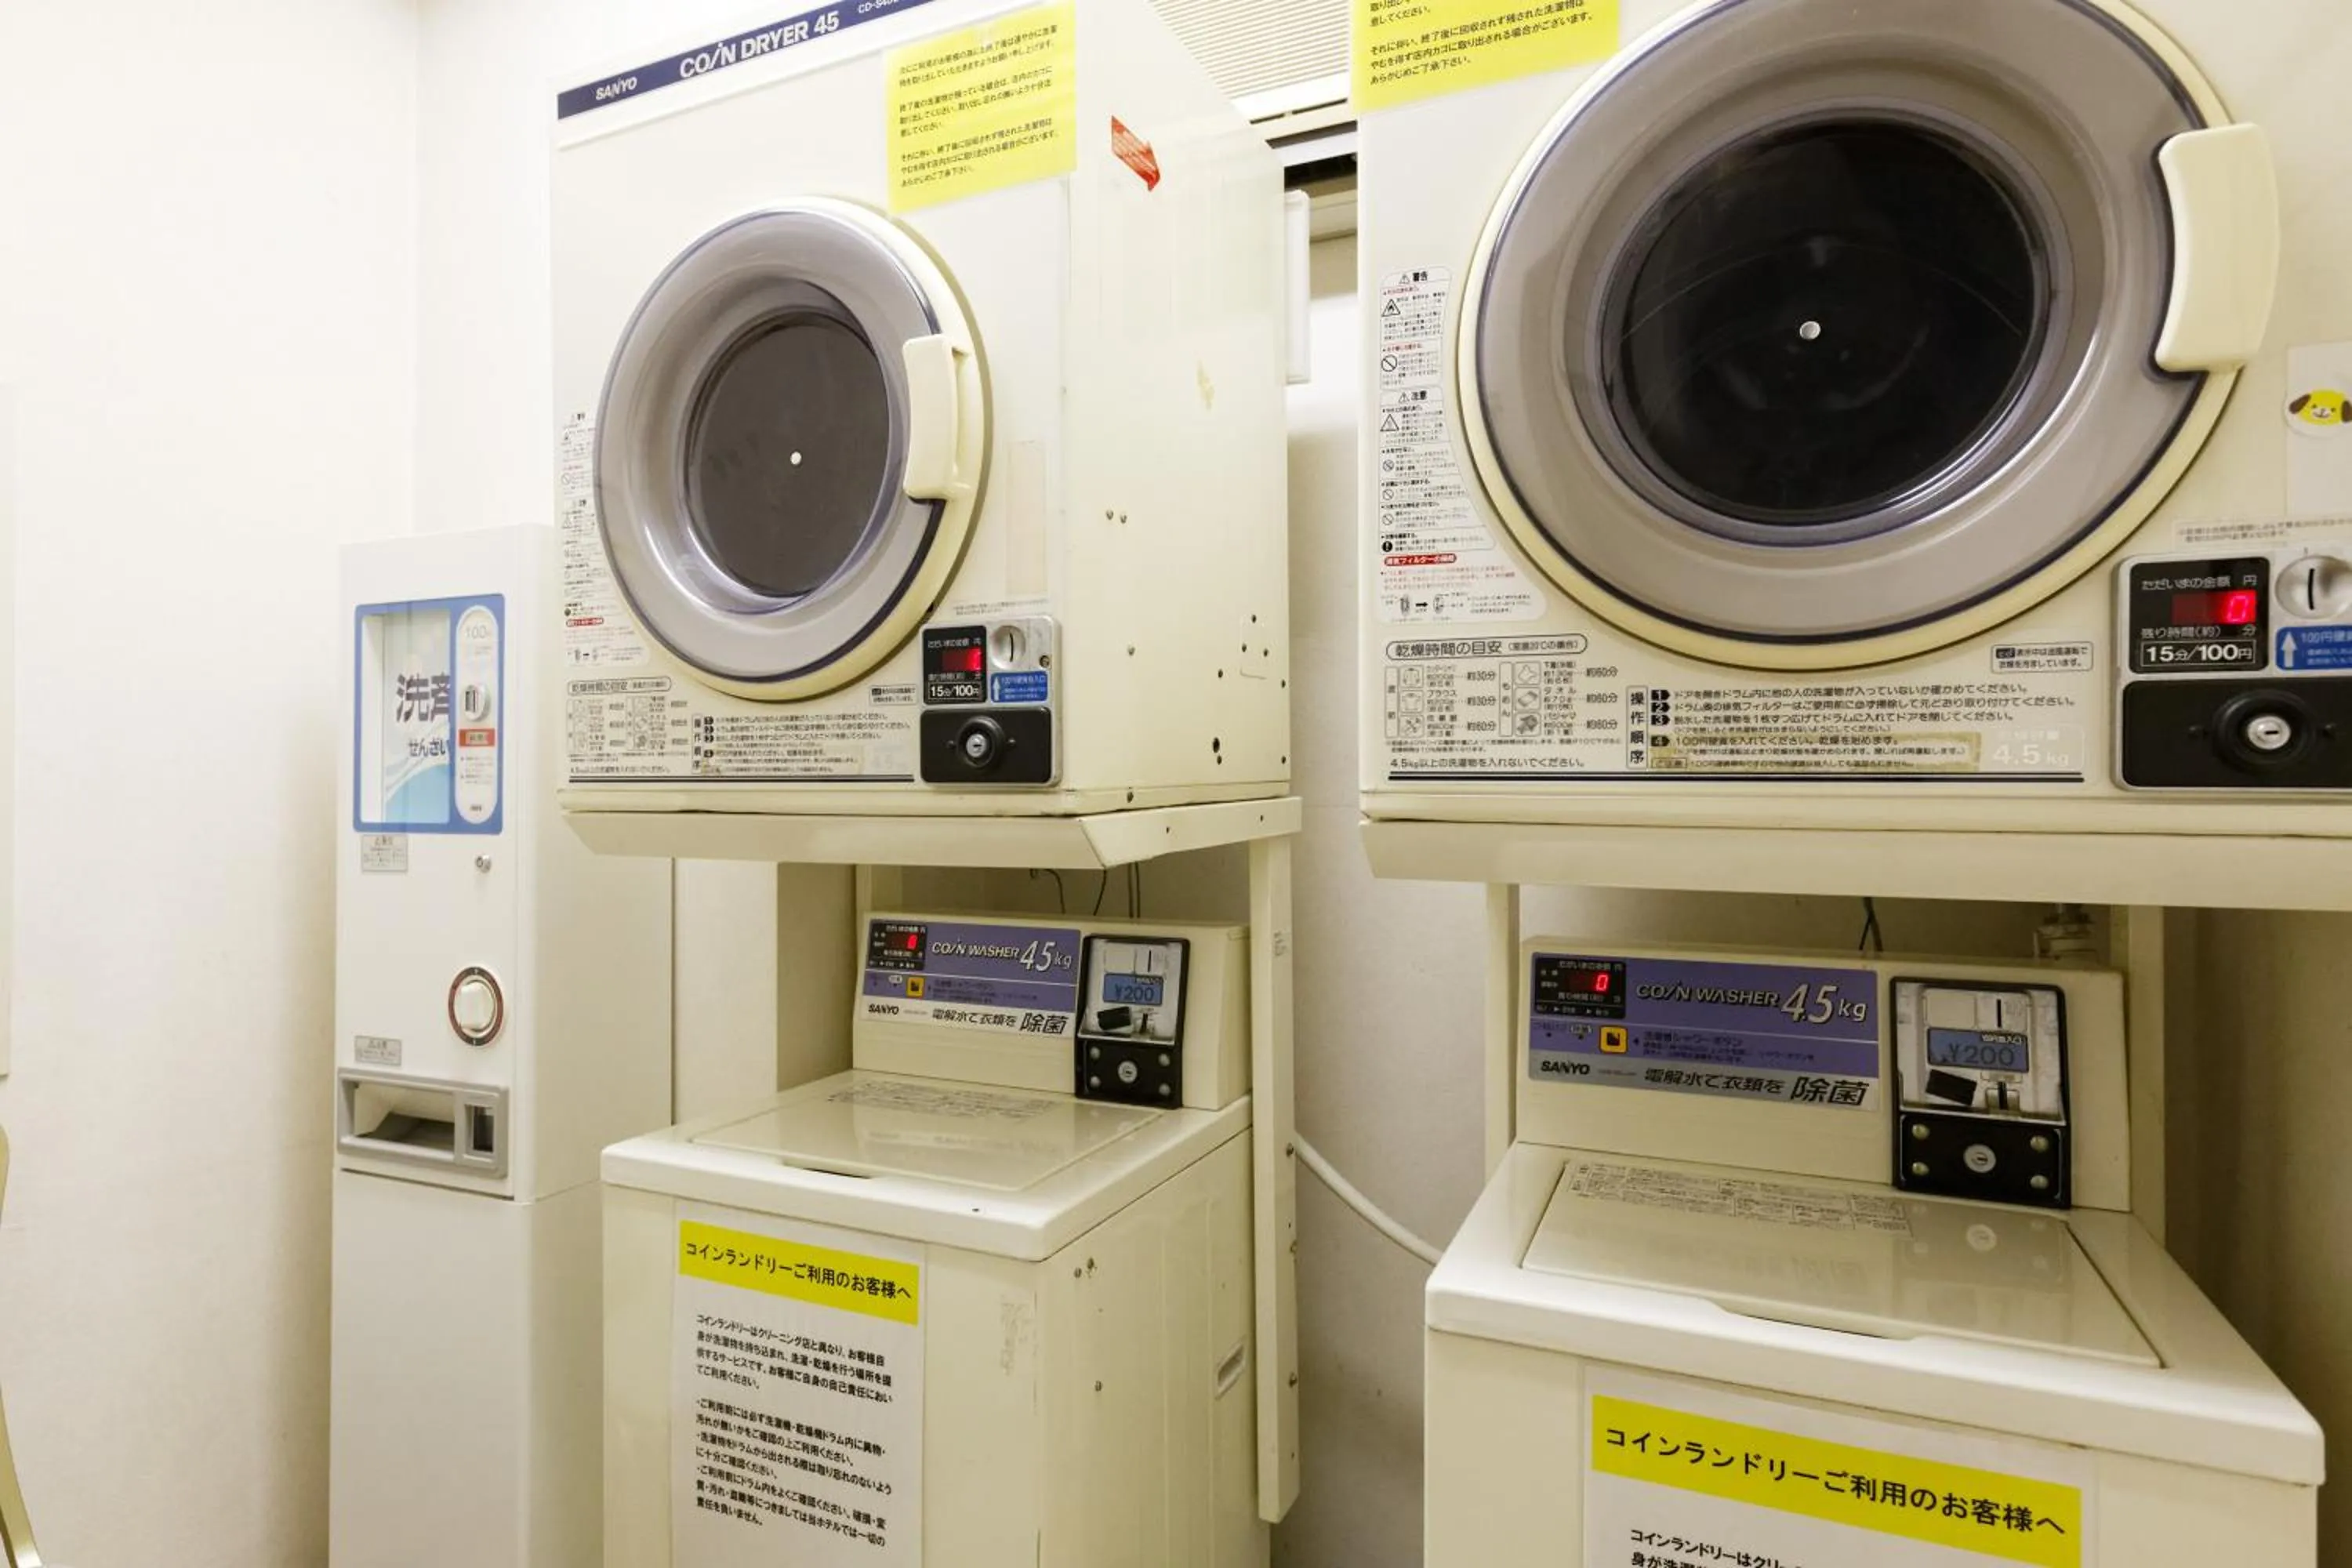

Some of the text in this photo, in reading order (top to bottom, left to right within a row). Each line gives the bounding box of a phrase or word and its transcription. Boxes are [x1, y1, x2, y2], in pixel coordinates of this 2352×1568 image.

[741, 21, 809, 60] DRYER
[813, 11, 840, 34] 45
[596, 77, 637, 101] SANYO
[2243, 574, 2256, 586] 円
[1396, 641, 1502, 657] 乾燥時間の目安
[1630, 691, 1644, 764] 操作順序
[969, 944, 1018, 958] WASHER
[1595, 975, 1608, 992] 0
[1115, 985, 1154, 1002] ¥200
[1696, 988, 1779, 1007] WASHER
[869, 1004, 898, 1015] SANYO
[1541, 1060, 1590, 1076] SANYO
[686, 1242, 912, 1299] コインランドリーご利用のお客様へ
[1606, 1428, 2066, 1534] コインランドリーご利用のお客様へ
